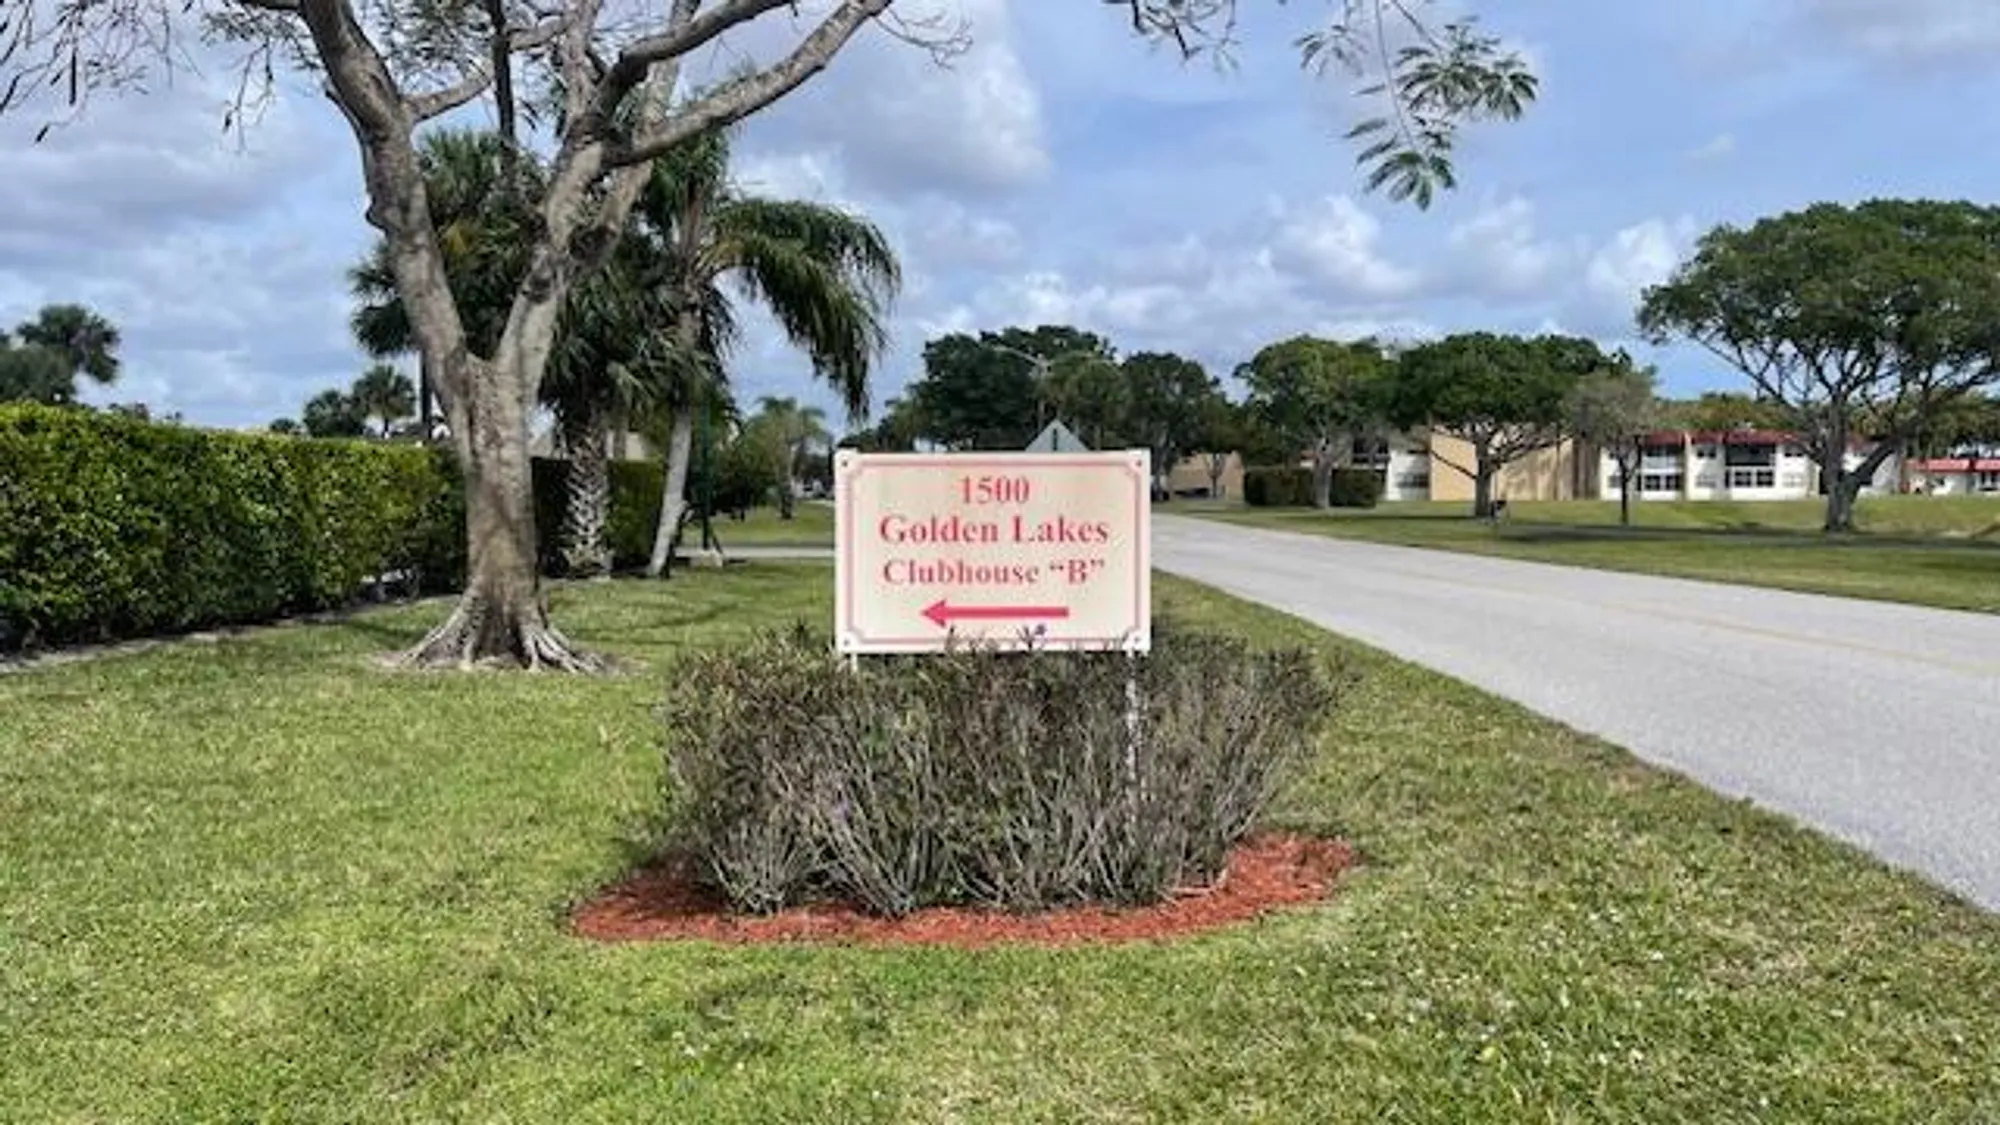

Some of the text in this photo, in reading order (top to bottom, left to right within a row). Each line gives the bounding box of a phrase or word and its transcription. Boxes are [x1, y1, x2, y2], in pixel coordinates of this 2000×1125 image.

[960, 476, 1031, 505] 1500
[879, 515, 1110, 543] Golden Lakes
[882, 558, 1040, 585] Clubhouse
